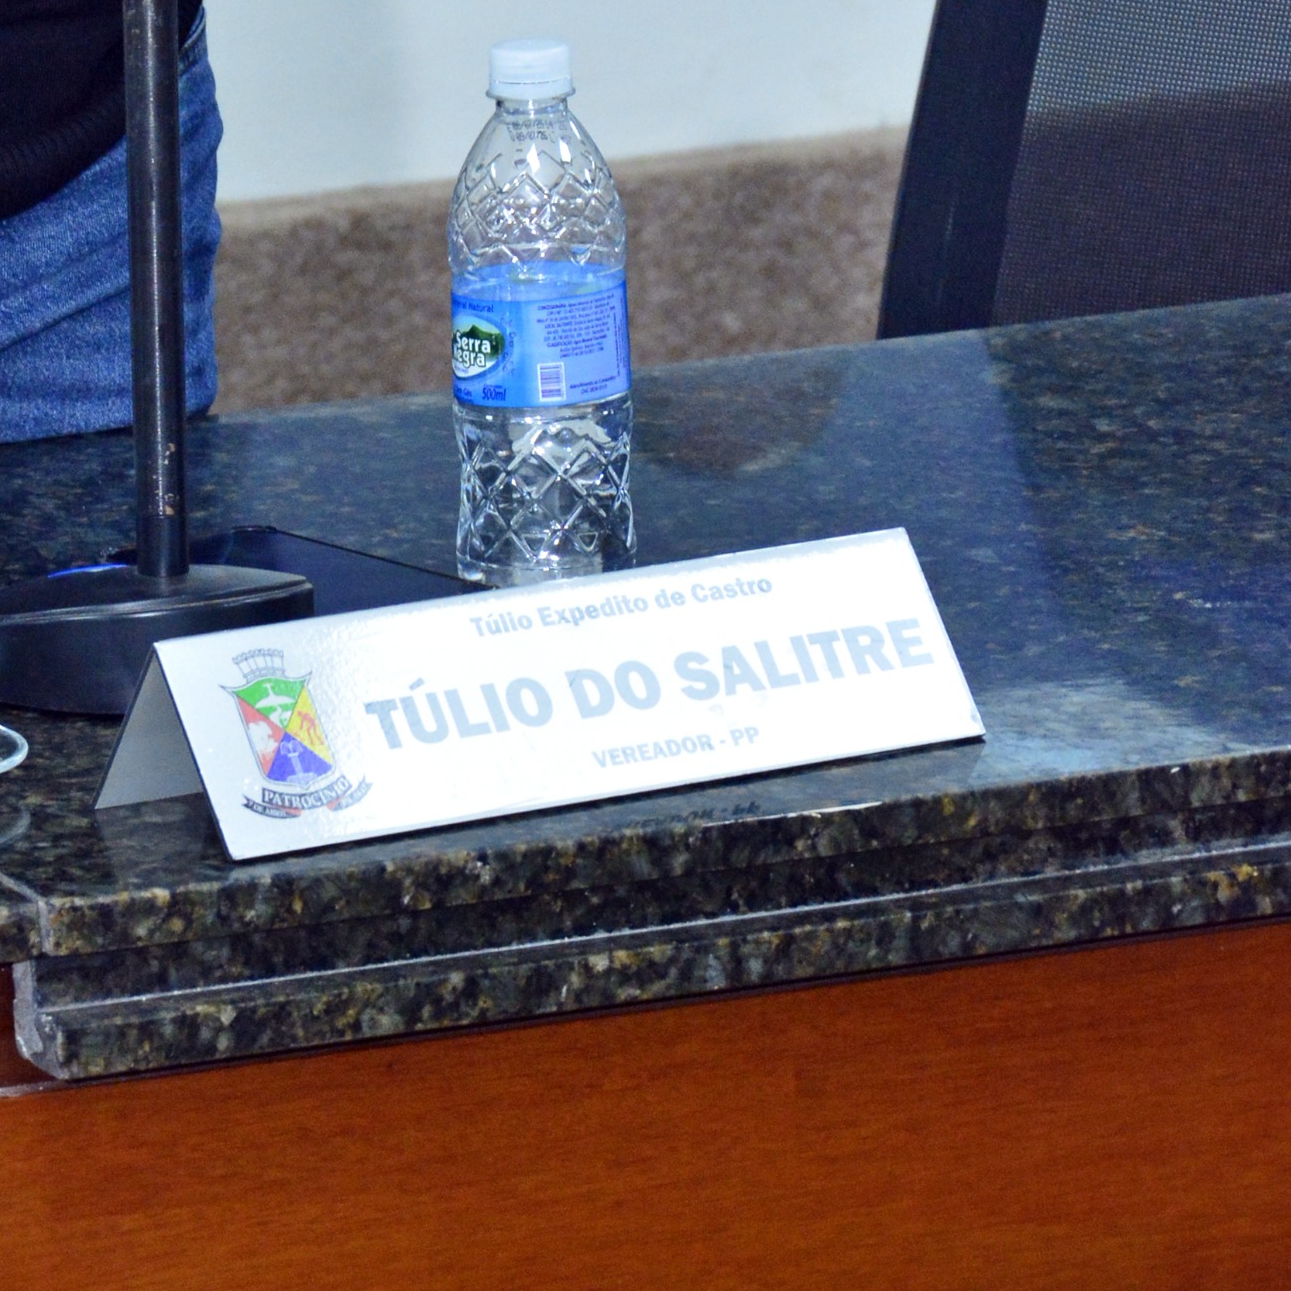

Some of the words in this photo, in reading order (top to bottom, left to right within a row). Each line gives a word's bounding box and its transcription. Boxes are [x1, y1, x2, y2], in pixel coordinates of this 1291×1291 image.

[456, 330, 491, 353] Serra
[470, 613, 533, 637] Túlio
[537, 593, 649, 626] Expedito
[654, 587, 686, 609] de
[690, 576, 773, 603] Castro
[364, 676, 554, 751] TÚLIO
[564, 659, 662, 719] DO
[673, 617, 936, 702] SALITRE
[591, 733, 715, 769] VEREADOR
[730, 726, 761, 746] PP
